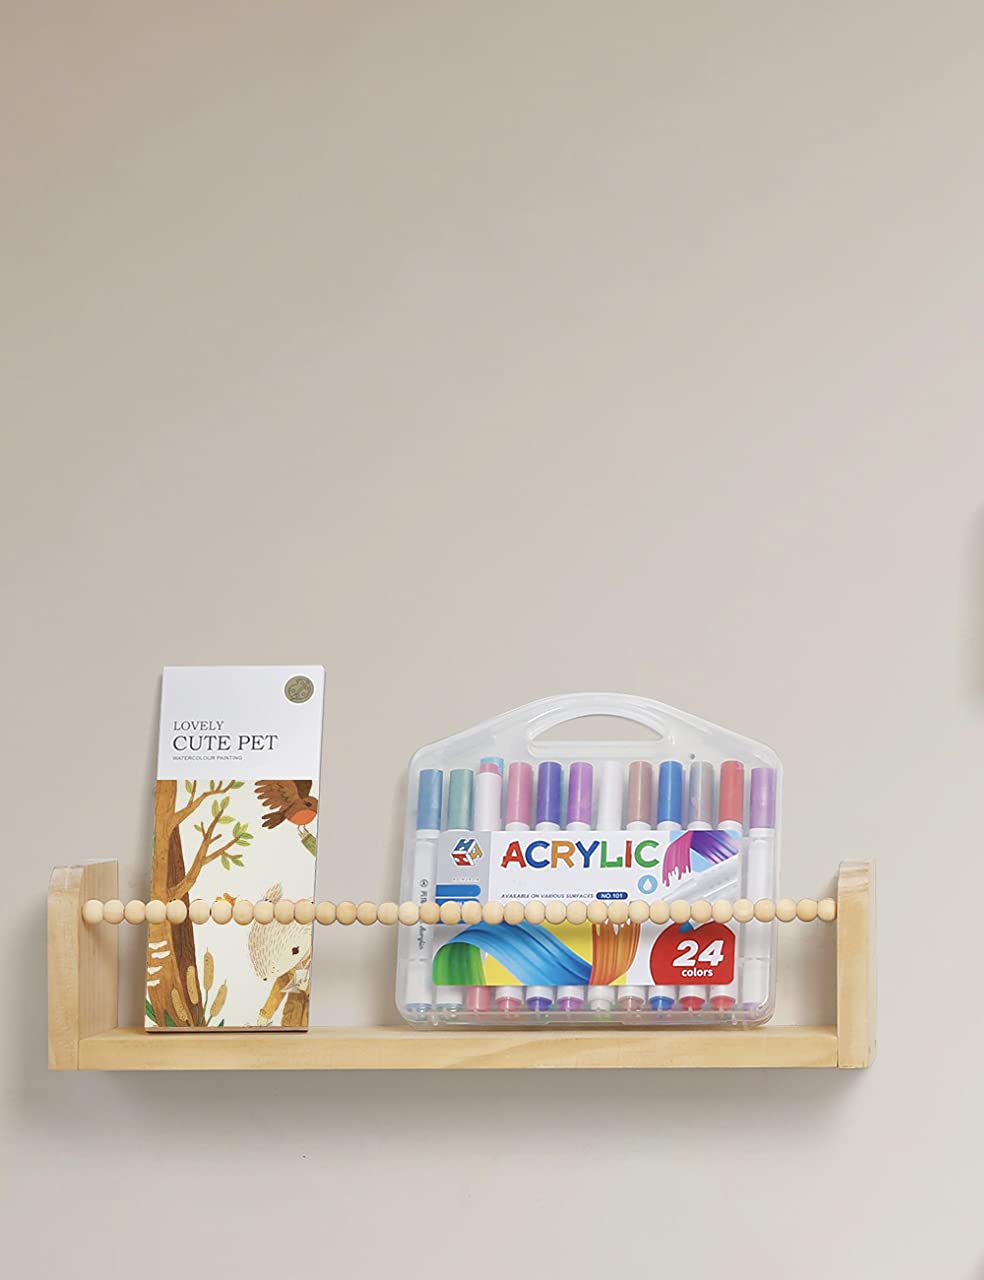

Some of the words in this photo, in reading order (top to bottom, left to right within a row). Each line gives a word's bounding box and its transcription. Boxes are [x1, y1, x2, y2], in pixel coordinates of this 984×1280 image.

[173, 720, 225, 731] LOVELY
[172, 735, 231, 751] CUTE
[238, 734, 279, 751] PET
[500, 840, 660, 869] ACRYLIC
[672, 939, 724, 967] 24
[681, 968, 714, 977] colors
